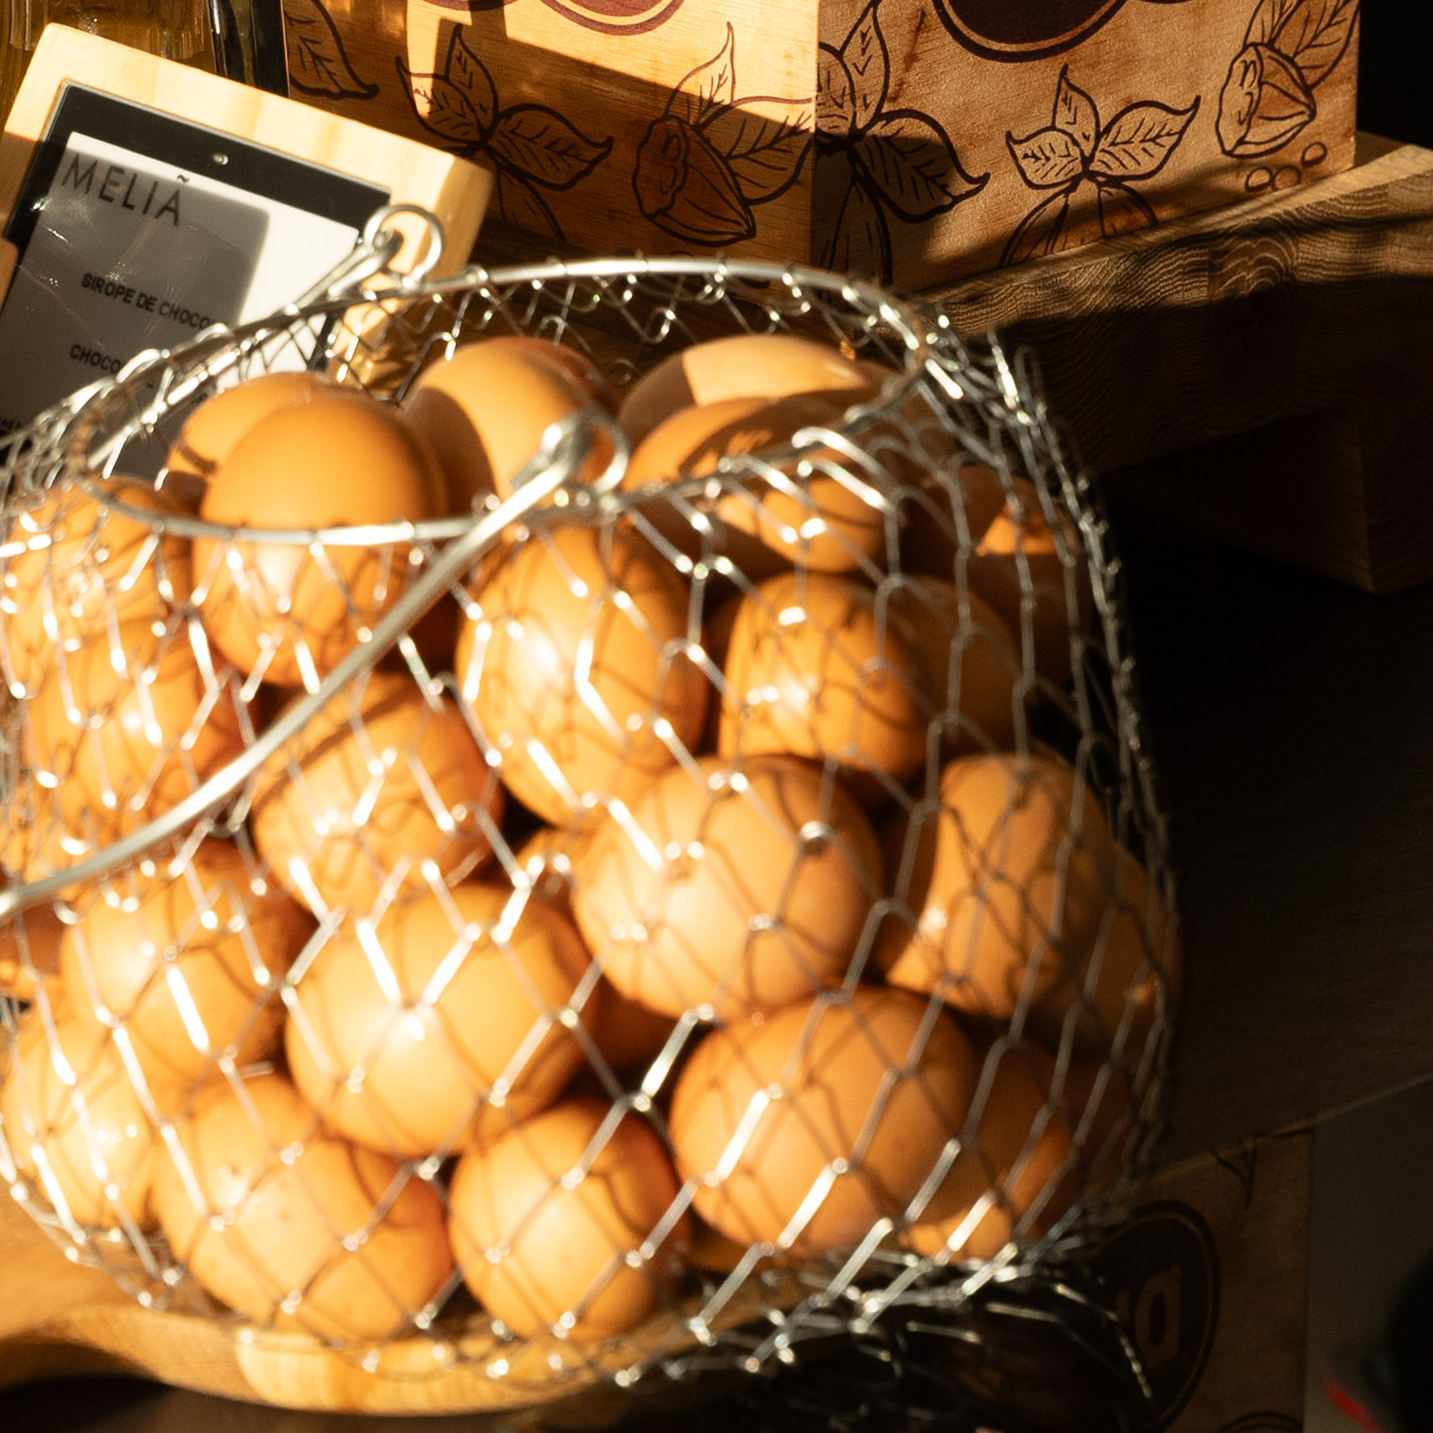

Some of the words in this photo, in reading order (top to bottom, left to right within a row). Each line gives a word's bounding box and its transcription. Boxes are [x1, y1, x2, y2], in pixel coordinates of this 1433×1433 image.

[82, 272, 136, 305] SIROPE
[135, 292, 159, 313] DE
[158, 301, 216, 331] CHOCO
[69, 343, 125, 375] CHOCO
